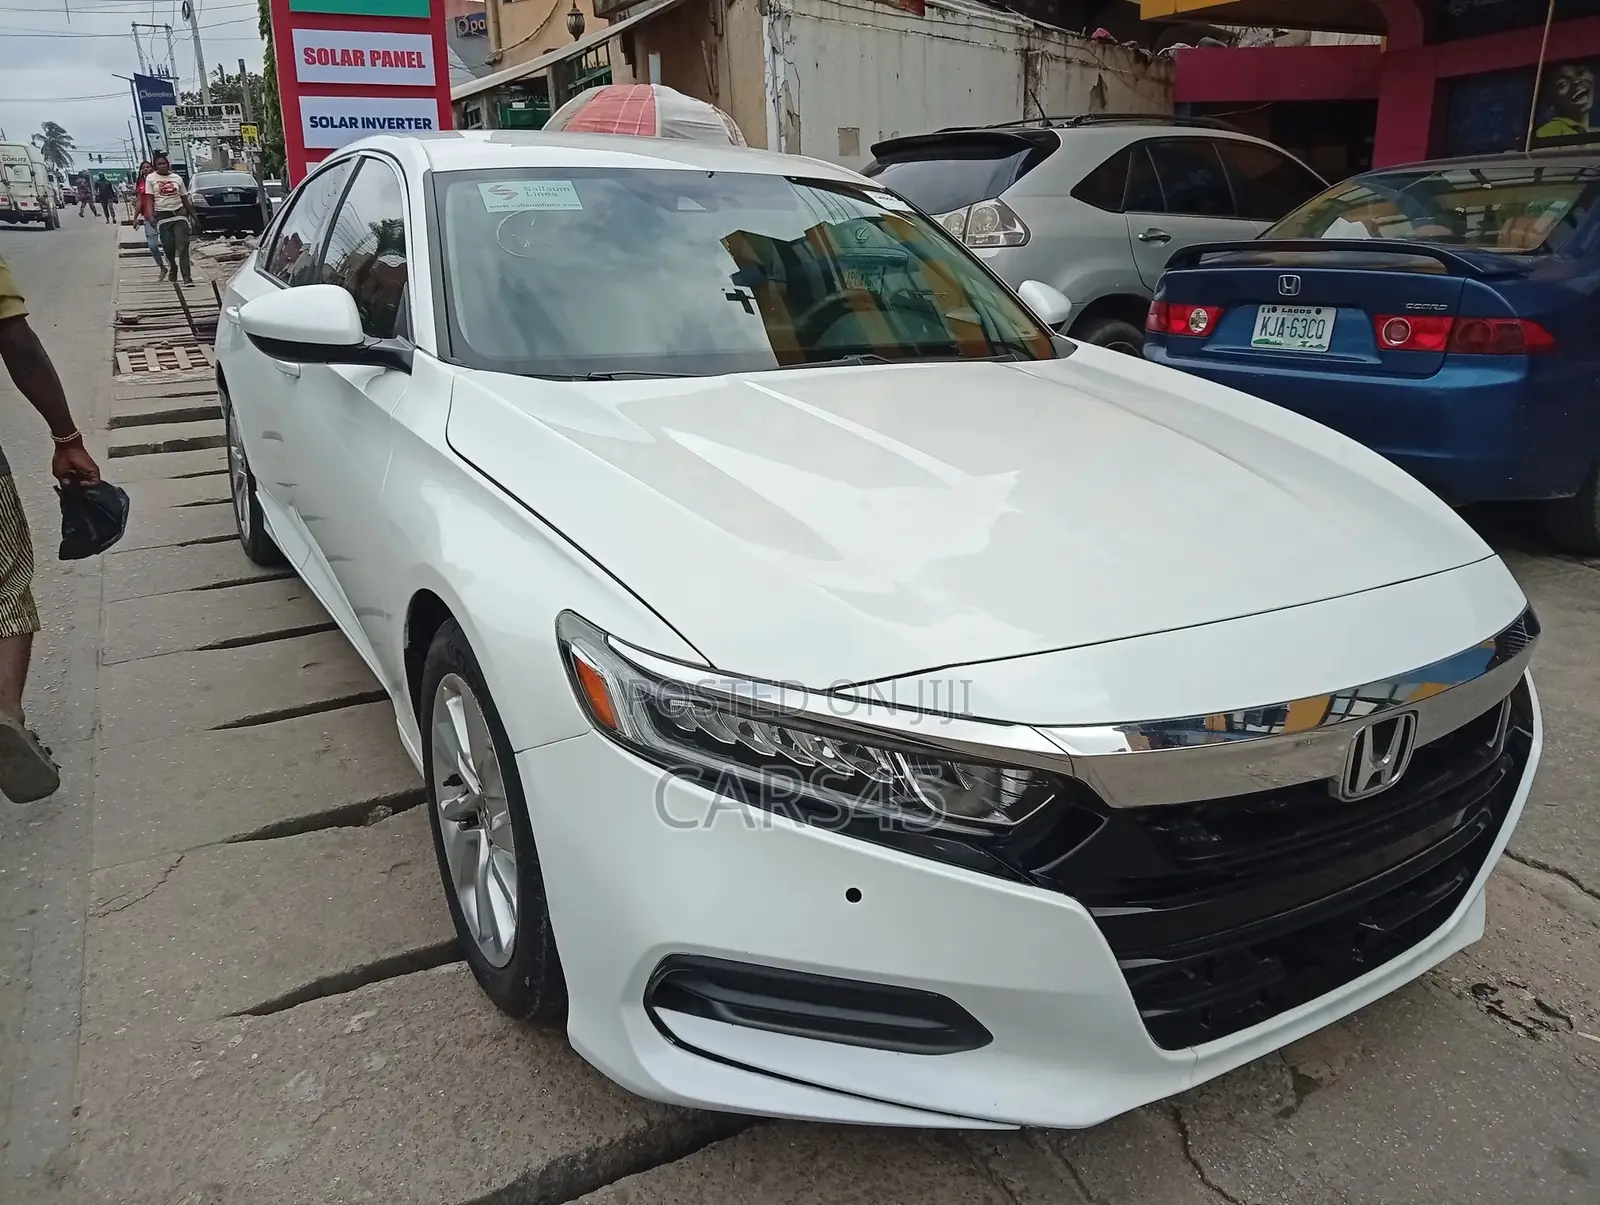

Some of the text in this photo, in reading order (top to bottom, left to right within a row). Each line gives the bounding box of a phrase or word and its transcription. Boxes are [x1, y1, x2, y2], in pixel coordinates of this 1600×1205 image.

[304, 47, 426, 69] SOLAR PANEL
[175, 106, 206, 117] BEAUTY
[225, 105, 240, 115] SPA
[309, 115, 432, 130] SOLAR INVERTER
[524, 184, 571, 192] Sallaum
[1281, 307, 1312, 315] LAGOS
